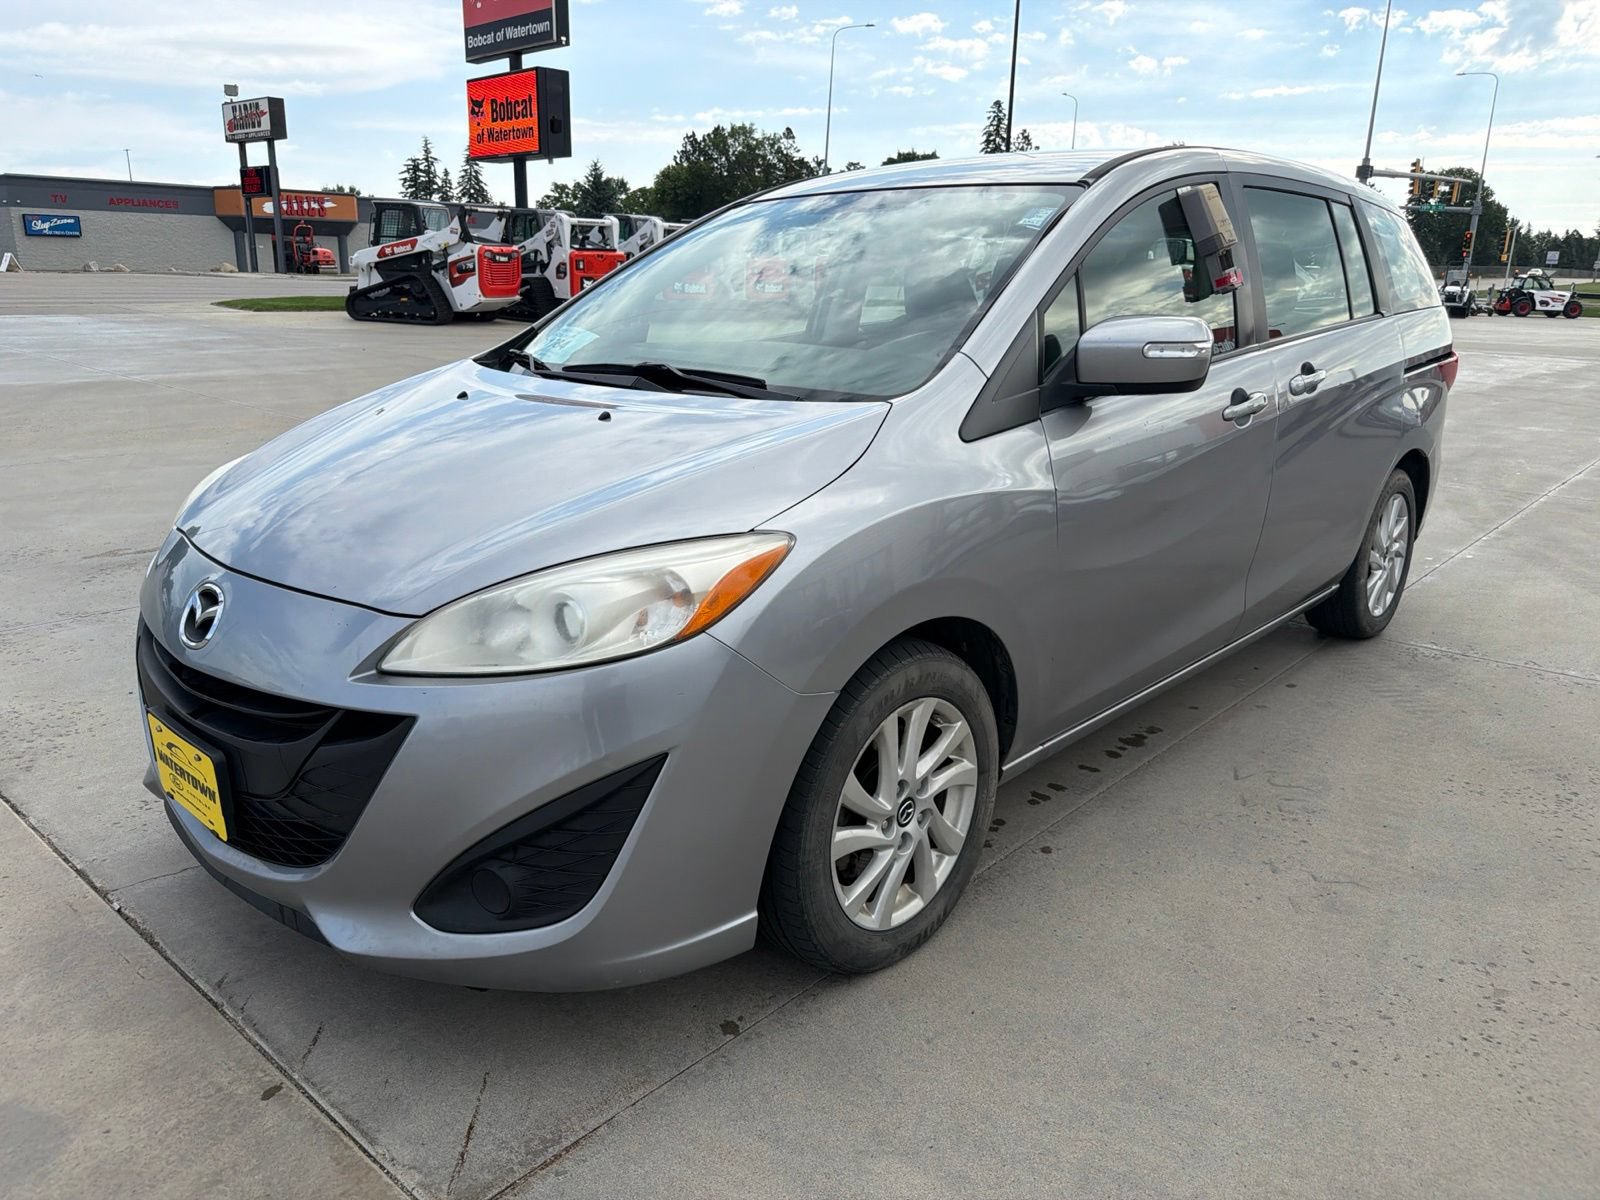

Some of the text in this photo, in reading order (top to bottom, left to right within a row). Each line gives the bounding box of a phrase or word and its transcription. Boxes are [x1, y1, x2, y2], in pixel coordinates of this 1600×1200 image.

[467, 20, 550, 48] Bobcat of Watertown
[490, 93, 533, 123] Bobcat
[476, 126, 534, 144] of Watertown
[50, 194, 179, 209] TV APPLIANCES
[394, 243, 412, 254] Bobcat
[157, 747, 217, 804] WATERTOWN
